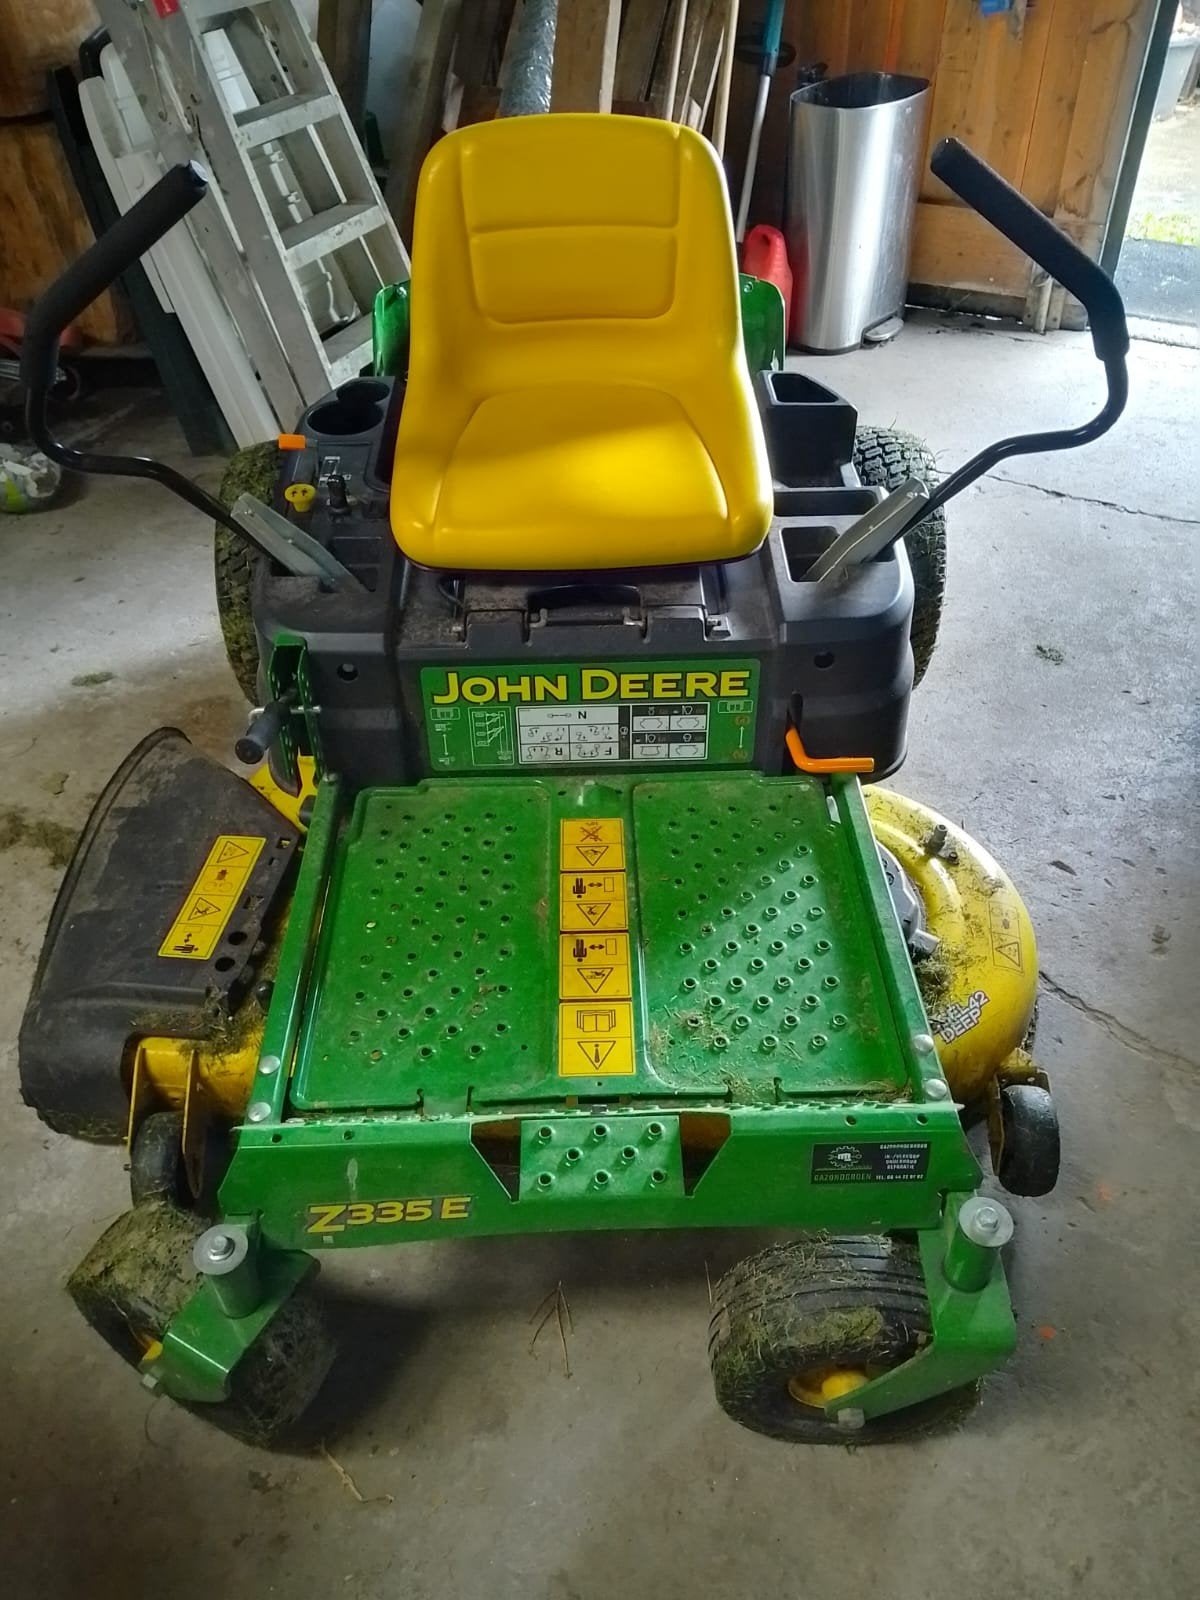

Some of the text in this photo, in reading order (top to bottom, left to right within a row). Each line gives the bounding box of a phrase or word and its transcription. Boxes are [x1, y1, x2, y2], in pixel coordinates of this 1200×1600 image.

[433, 669, 750, 704] JOHN DEERE
[577, 711, 587, 719] N
[555, 747, 563, 756] R
[604, 747, 612, 756] F
[970, 991, 989, 1009] 42
[940, 1008, 981, 1043] DEEP
[307, 1196, 472, 1233] Z335 E
